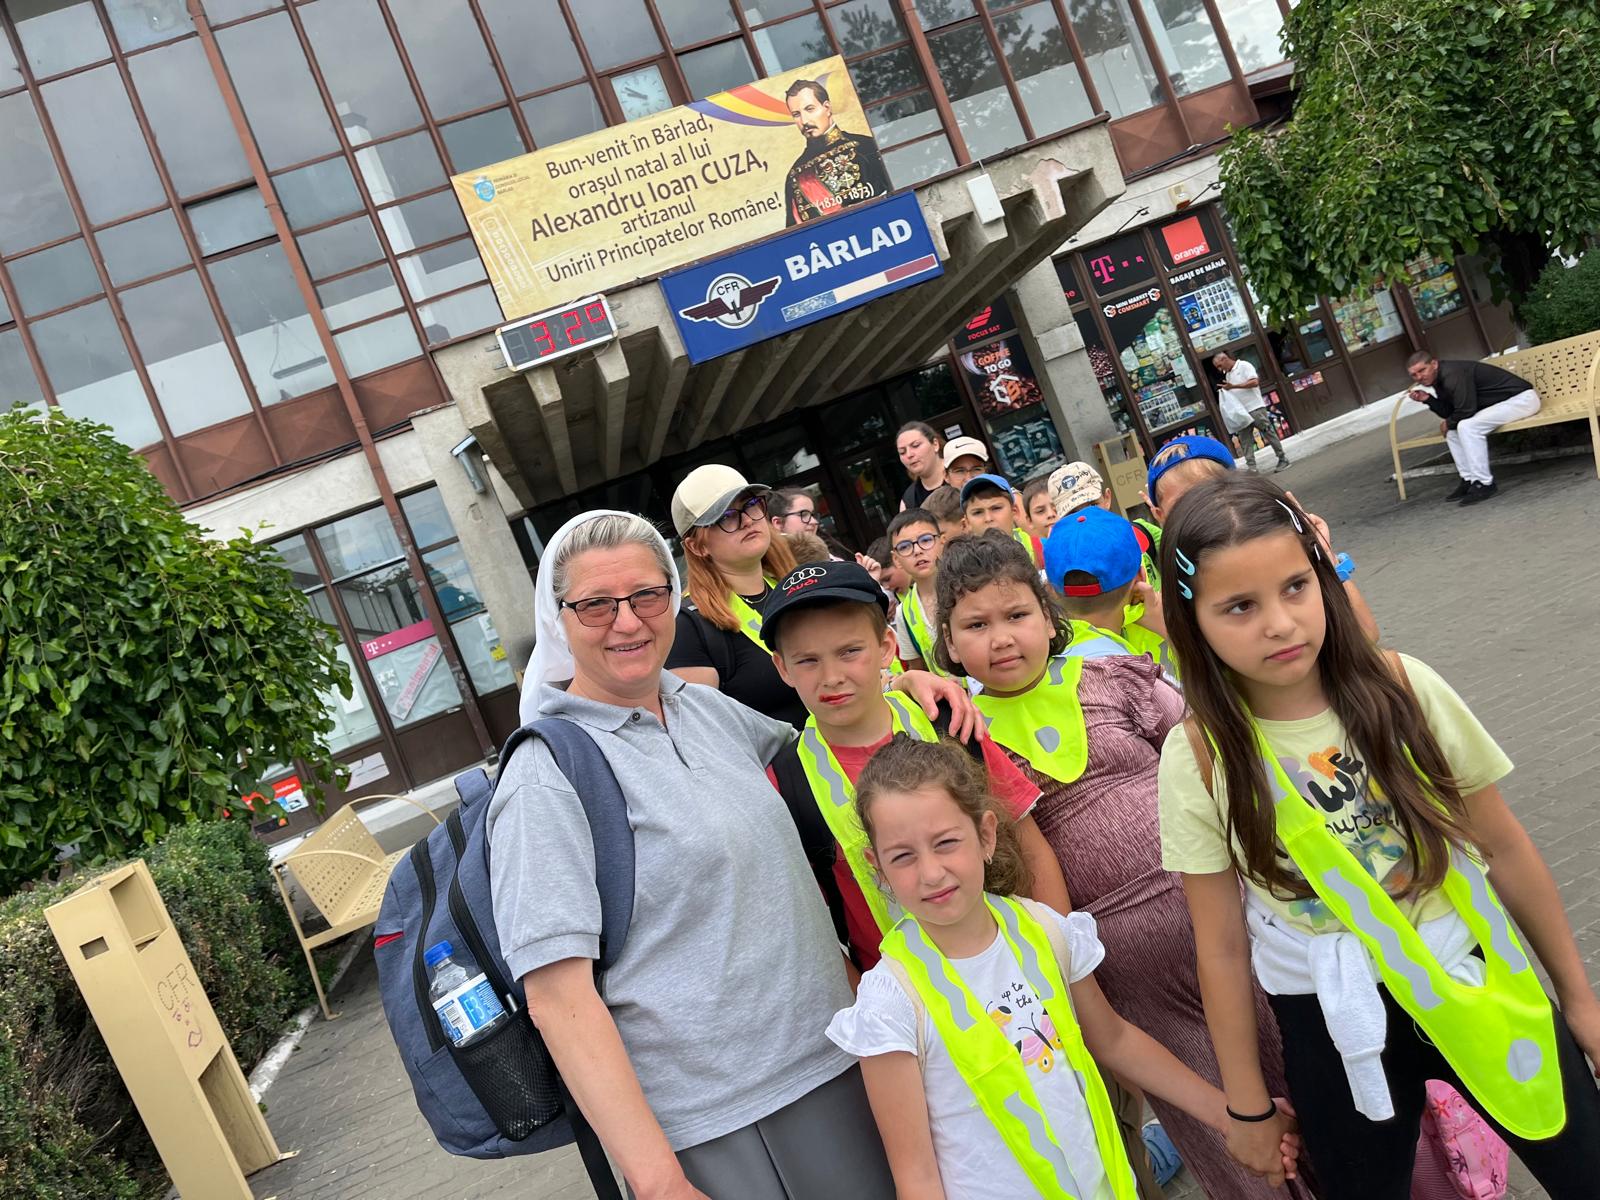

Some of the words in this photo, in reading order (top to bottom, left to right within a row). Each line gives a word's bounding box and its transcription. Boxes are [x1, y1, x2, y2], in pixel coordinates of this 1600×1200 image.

[546, 139, 631, 179] Bun-venit
[630, 134, 651, 152] în
[651, 113, 713, 145] Bârlad,
[568, 166, 622, 199] orașul
[625, 152, 669, 181] natal
[671, 145, 687, 167] al
[688, 138, 712, 160] lui
[531, 191, 645, 241] Alexandru
[647, 174, 699, 203] Ioan
[701, 148, 769, 184] CUZA,
[620, 195, 696, 234] artizanul
[546, 252, 596, 283] Unirii
[597, 218, 706, 269] Principatelor
[708, 191, 783, 230] Române!
[784, 219, 913, 282] BÂRLAD
[1173, 243, 1205, 261] orange
[1169, 272, 1195, 285] BAGAJE
[1195, 267, 1205, 276] DE
[716, 281, 741, 297] CFR
[1128, 292, 1149, 305] MARKET
[968, 328, 989, 340] FOCUS
[989, 324, 1001, 334] SAT
[984, 364, 998, 374] TO
[998, 358, 1012, 370] GO
[1115, 468, 1145, 487] CFR
[1001, 990, 1011, 1002] up
[1011, 982, 1024, 992] to
[1015, 994, 1033, 1009] the
